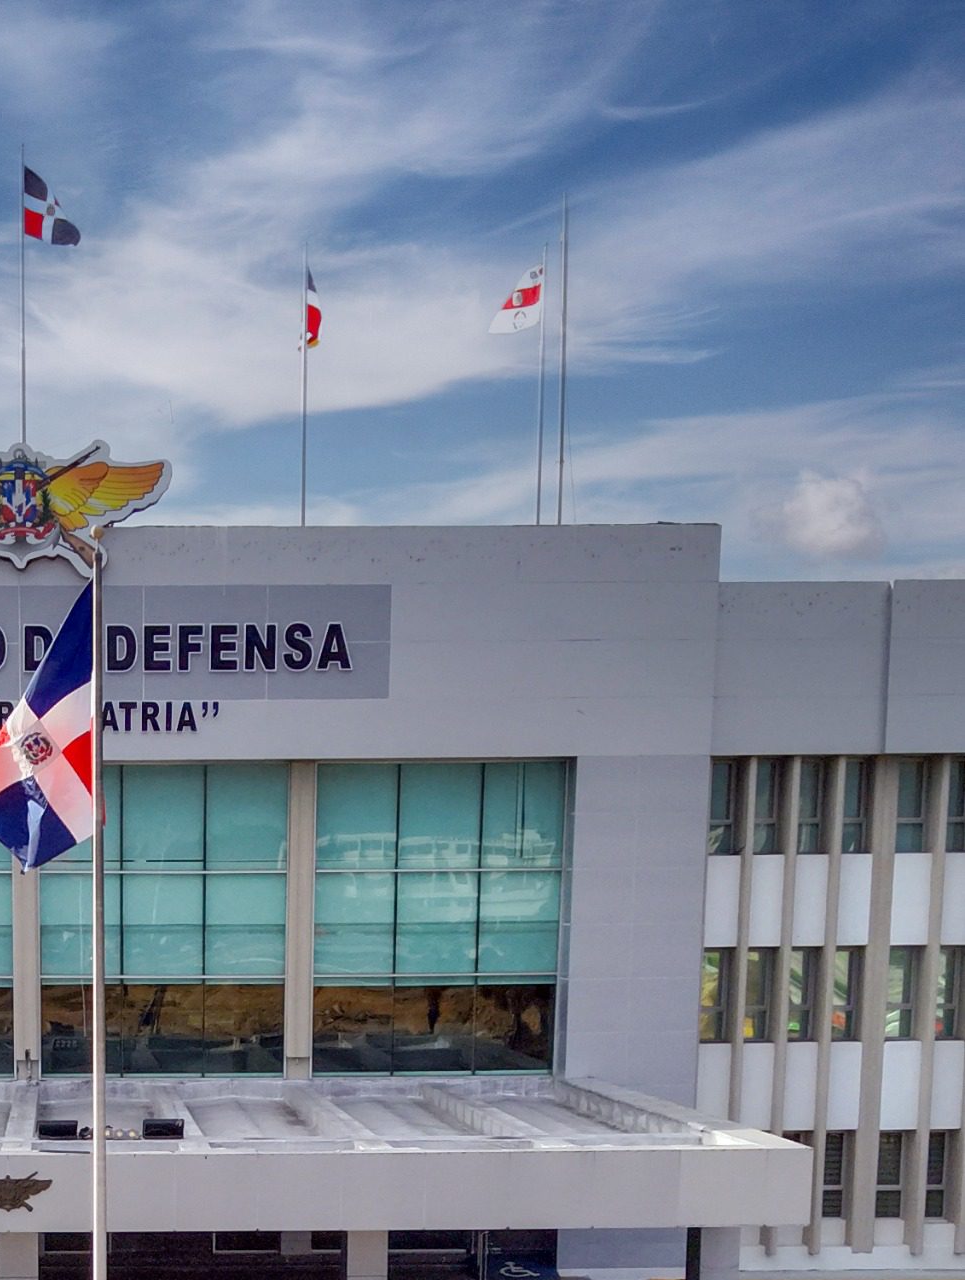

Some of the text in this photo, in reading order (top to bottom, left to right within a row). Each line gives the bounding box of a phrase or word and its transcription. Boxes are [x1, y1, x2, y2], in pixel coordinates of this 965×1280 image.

[23, 623, 55, 673] D
[105, 622, 353, 673] DEFENSA
[100, 700, 220, 732] ATRIA”
